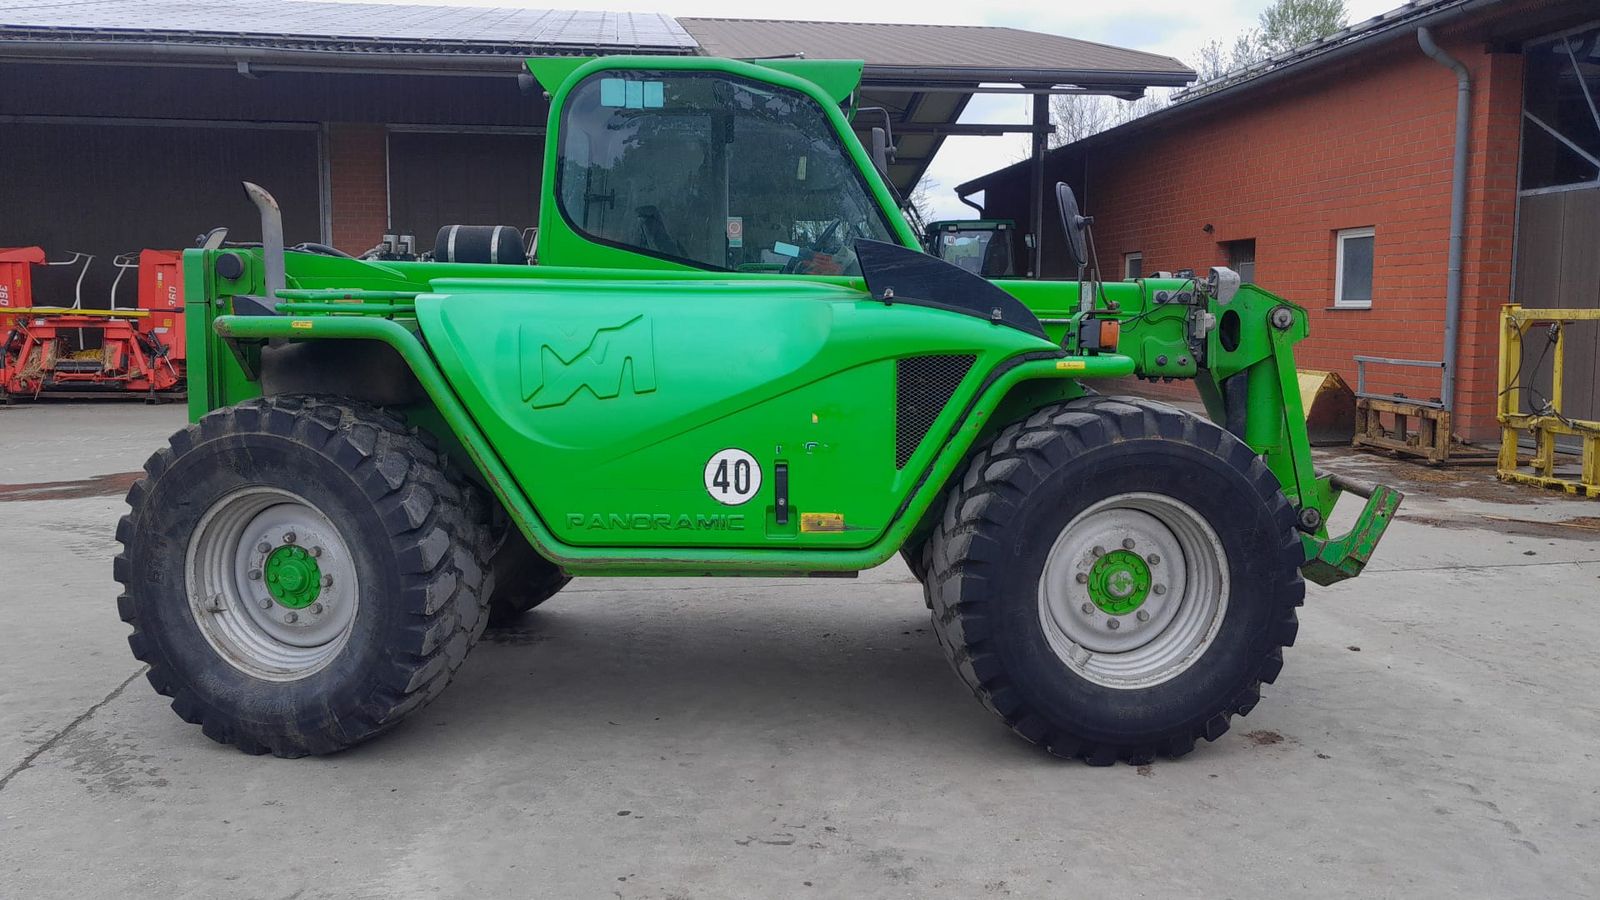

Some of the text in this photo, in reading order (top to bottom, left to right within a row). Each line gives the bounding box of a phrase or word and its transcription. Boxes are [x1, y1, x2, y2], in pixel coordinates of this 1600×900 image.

[0, 284, 9, 306] 360
[168, 286, 177, 307] 360
[713, 459, 750, 495] 40
[566, 513, 745, 531] PANORAMIC
